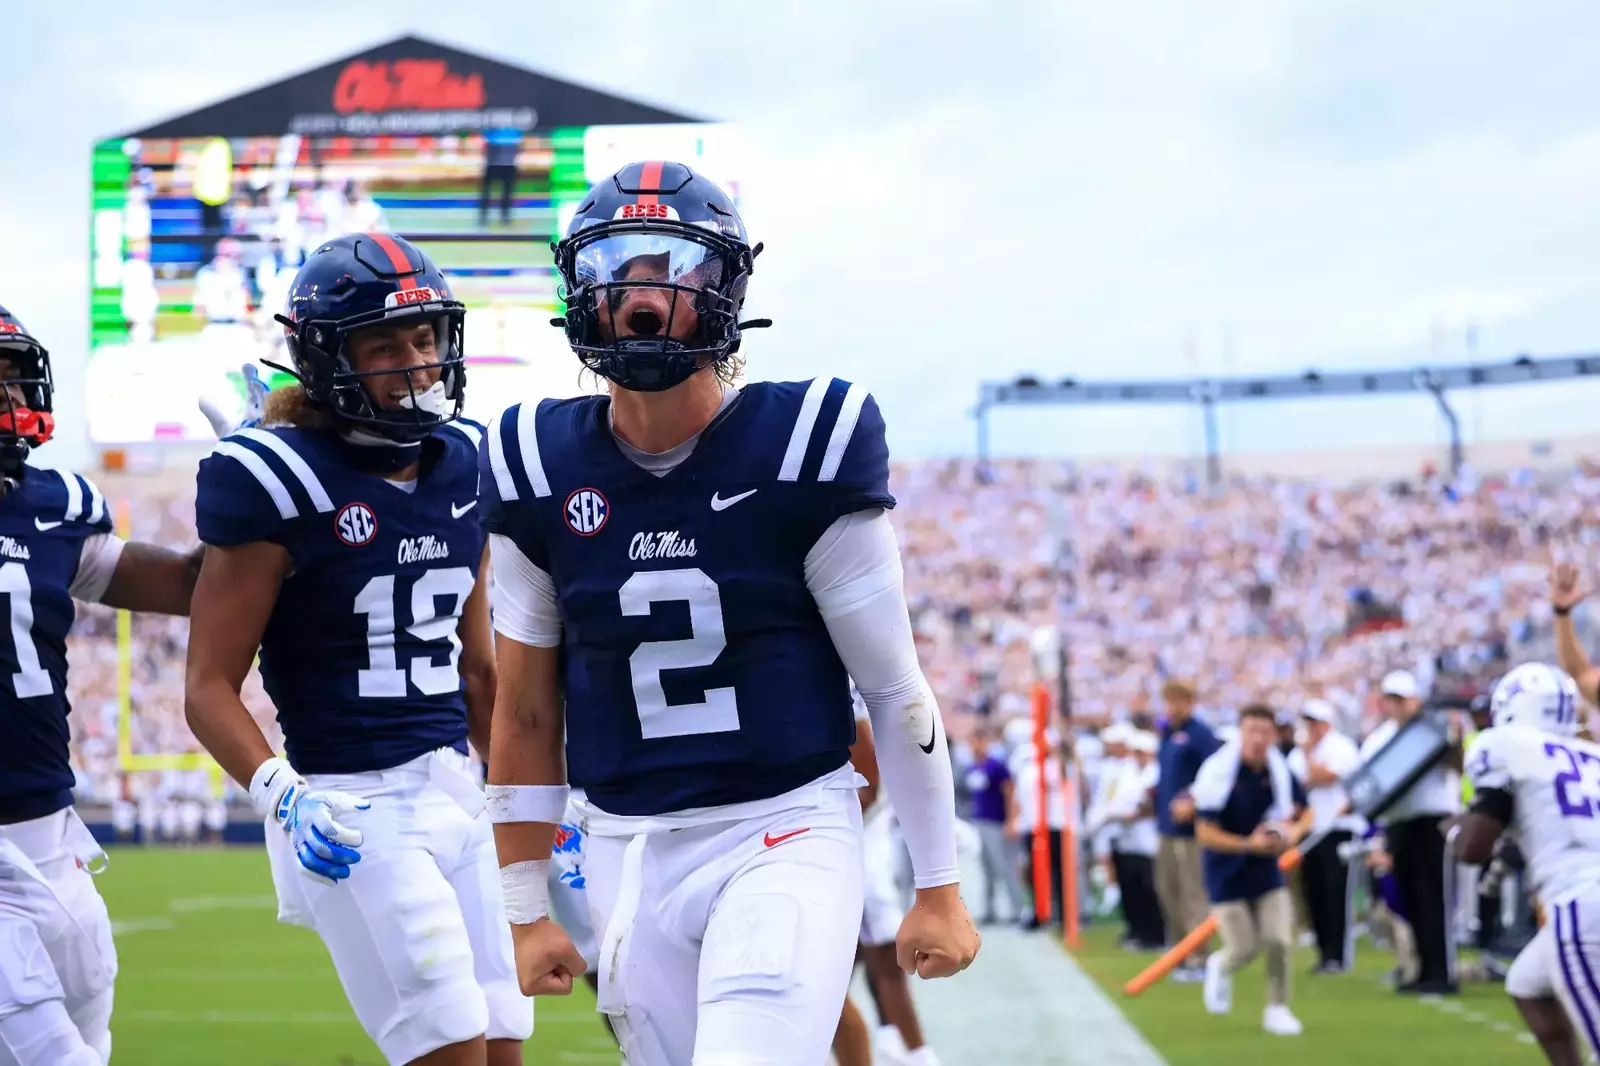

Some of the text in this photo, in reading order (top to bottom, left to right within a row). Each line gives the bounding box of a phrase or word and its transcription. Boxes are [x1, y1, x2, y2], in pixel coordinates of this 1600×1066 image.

[622, 204, 668, 218] REBS
[395, 288, 432, 305] REBS
[338, 505, 375, 543] SEC
[567, 491, 605, 533] SEC
[0, 535, 31, 560] Miss
[398, 535, 449, 564] Ole Miss
[628, 530, 698, 561] Ole Miss
[353, 566, 475, 697] 19
[618, 567, 741, 739] 2
